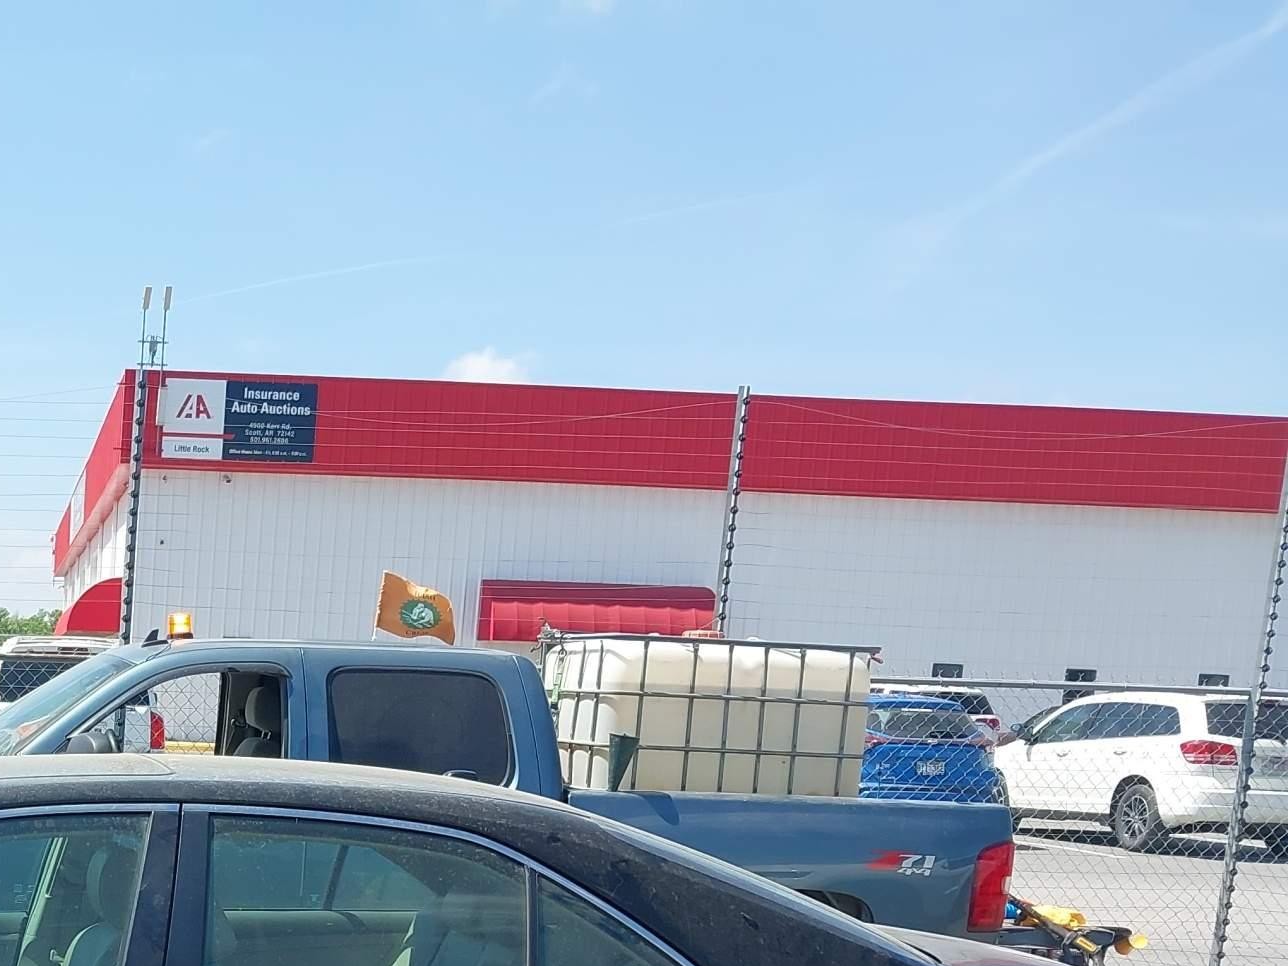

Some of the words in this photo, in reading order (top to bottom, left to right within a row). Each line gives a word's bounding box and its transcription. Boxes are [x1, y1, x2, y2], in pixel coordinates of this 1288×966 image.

[243, 386, 300, 401] Insurance
[231, 401, 258, 414] Auto
[260, 402, 311, 416] Auctions
[264, 429, 274, 437] AR
[277, 430, 295, 438] 72142
[174, 445, 191, 453] Little
[192, 445, 210, 453] Rock
